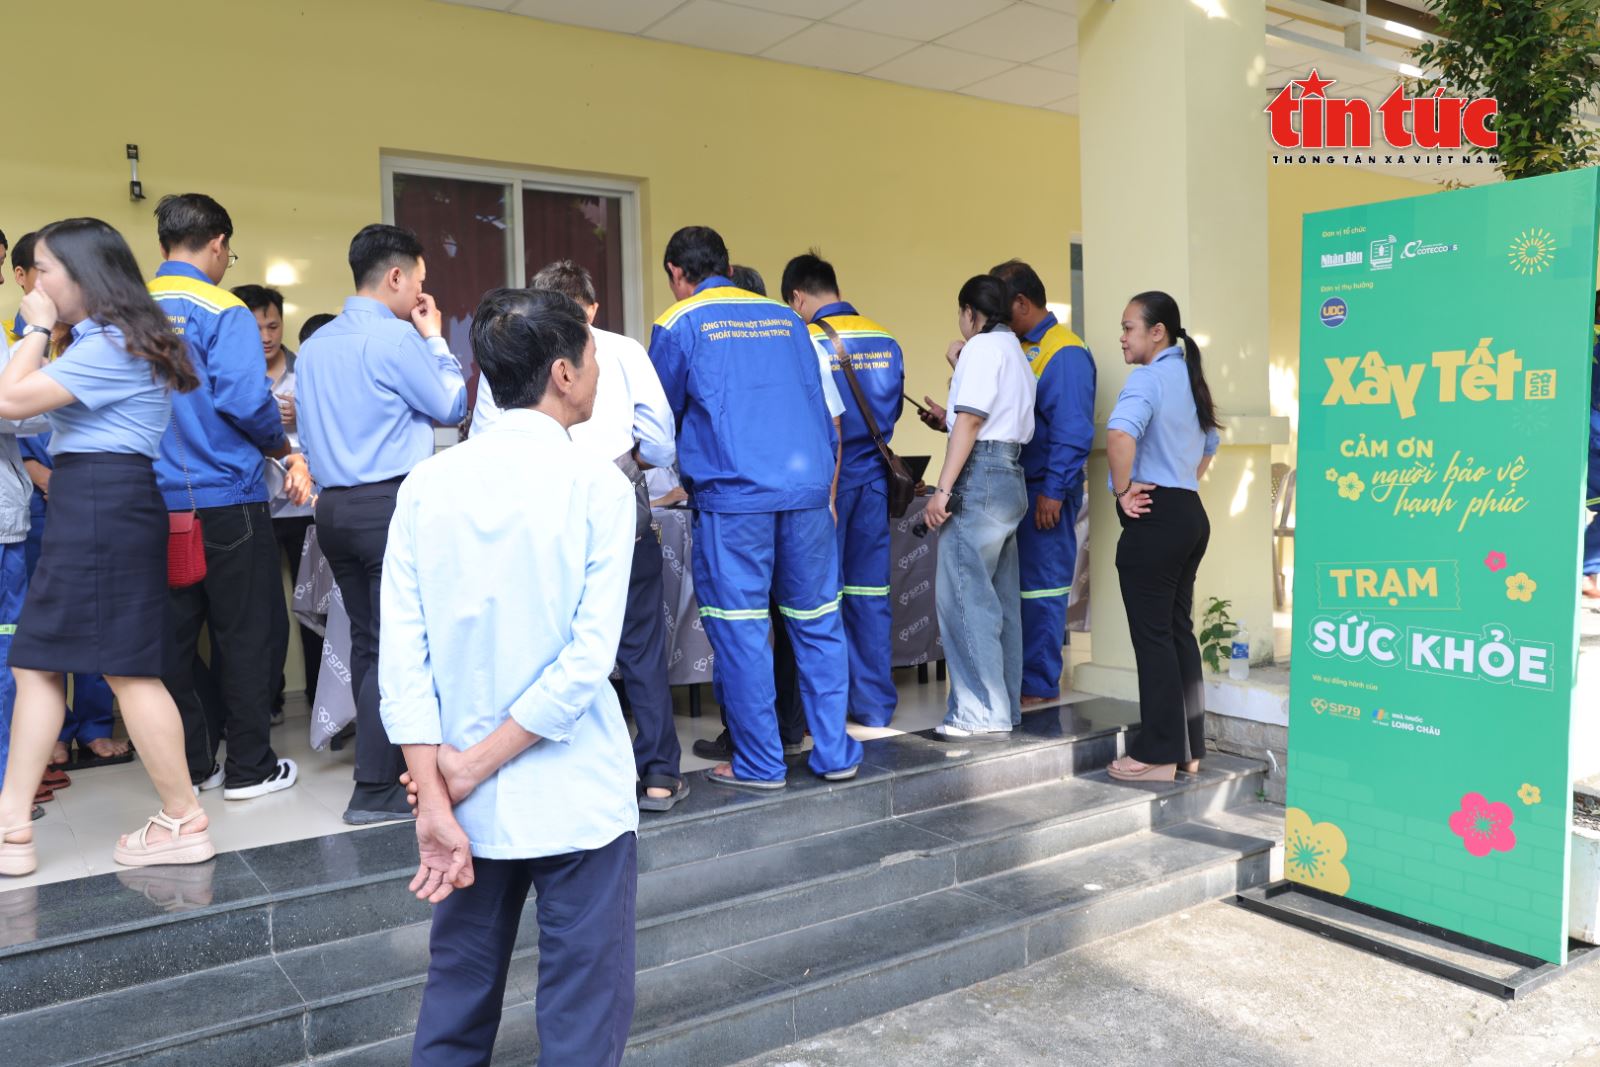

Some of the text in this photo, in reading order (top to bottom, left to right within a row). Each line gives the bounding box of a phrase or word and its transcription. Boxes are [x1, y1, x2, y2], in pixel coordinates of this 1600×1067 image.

[1321, 251, 1363, 266] Nhân Dân
[1323, 305, 1345, 316] UDC
[701, 320, 719, 332] CÔNG
[708, 328, 731, 341] THOÁT
[1340, 433, 1434, 458] CẢM ƠN
[1371, 450, 1529, 502] người bảo vệ
[1393, 482, 1529, 532] hạnh phúc
[908, 544, 928, 561] SP79
[908, 580, 929, 597] SP79
[1329, 567, 1438, 607] TRẠM
[908, 616, 929, 633] SP79
[1312, 615, 1548, 684] SỨC KHỎE
[327, 653, 352, 683] SP79
[1329, 702, 1361, 717] SP79
[1391, 720, 1414, 731] LONG
[1416, 724, 1440, 736] CHÂU
